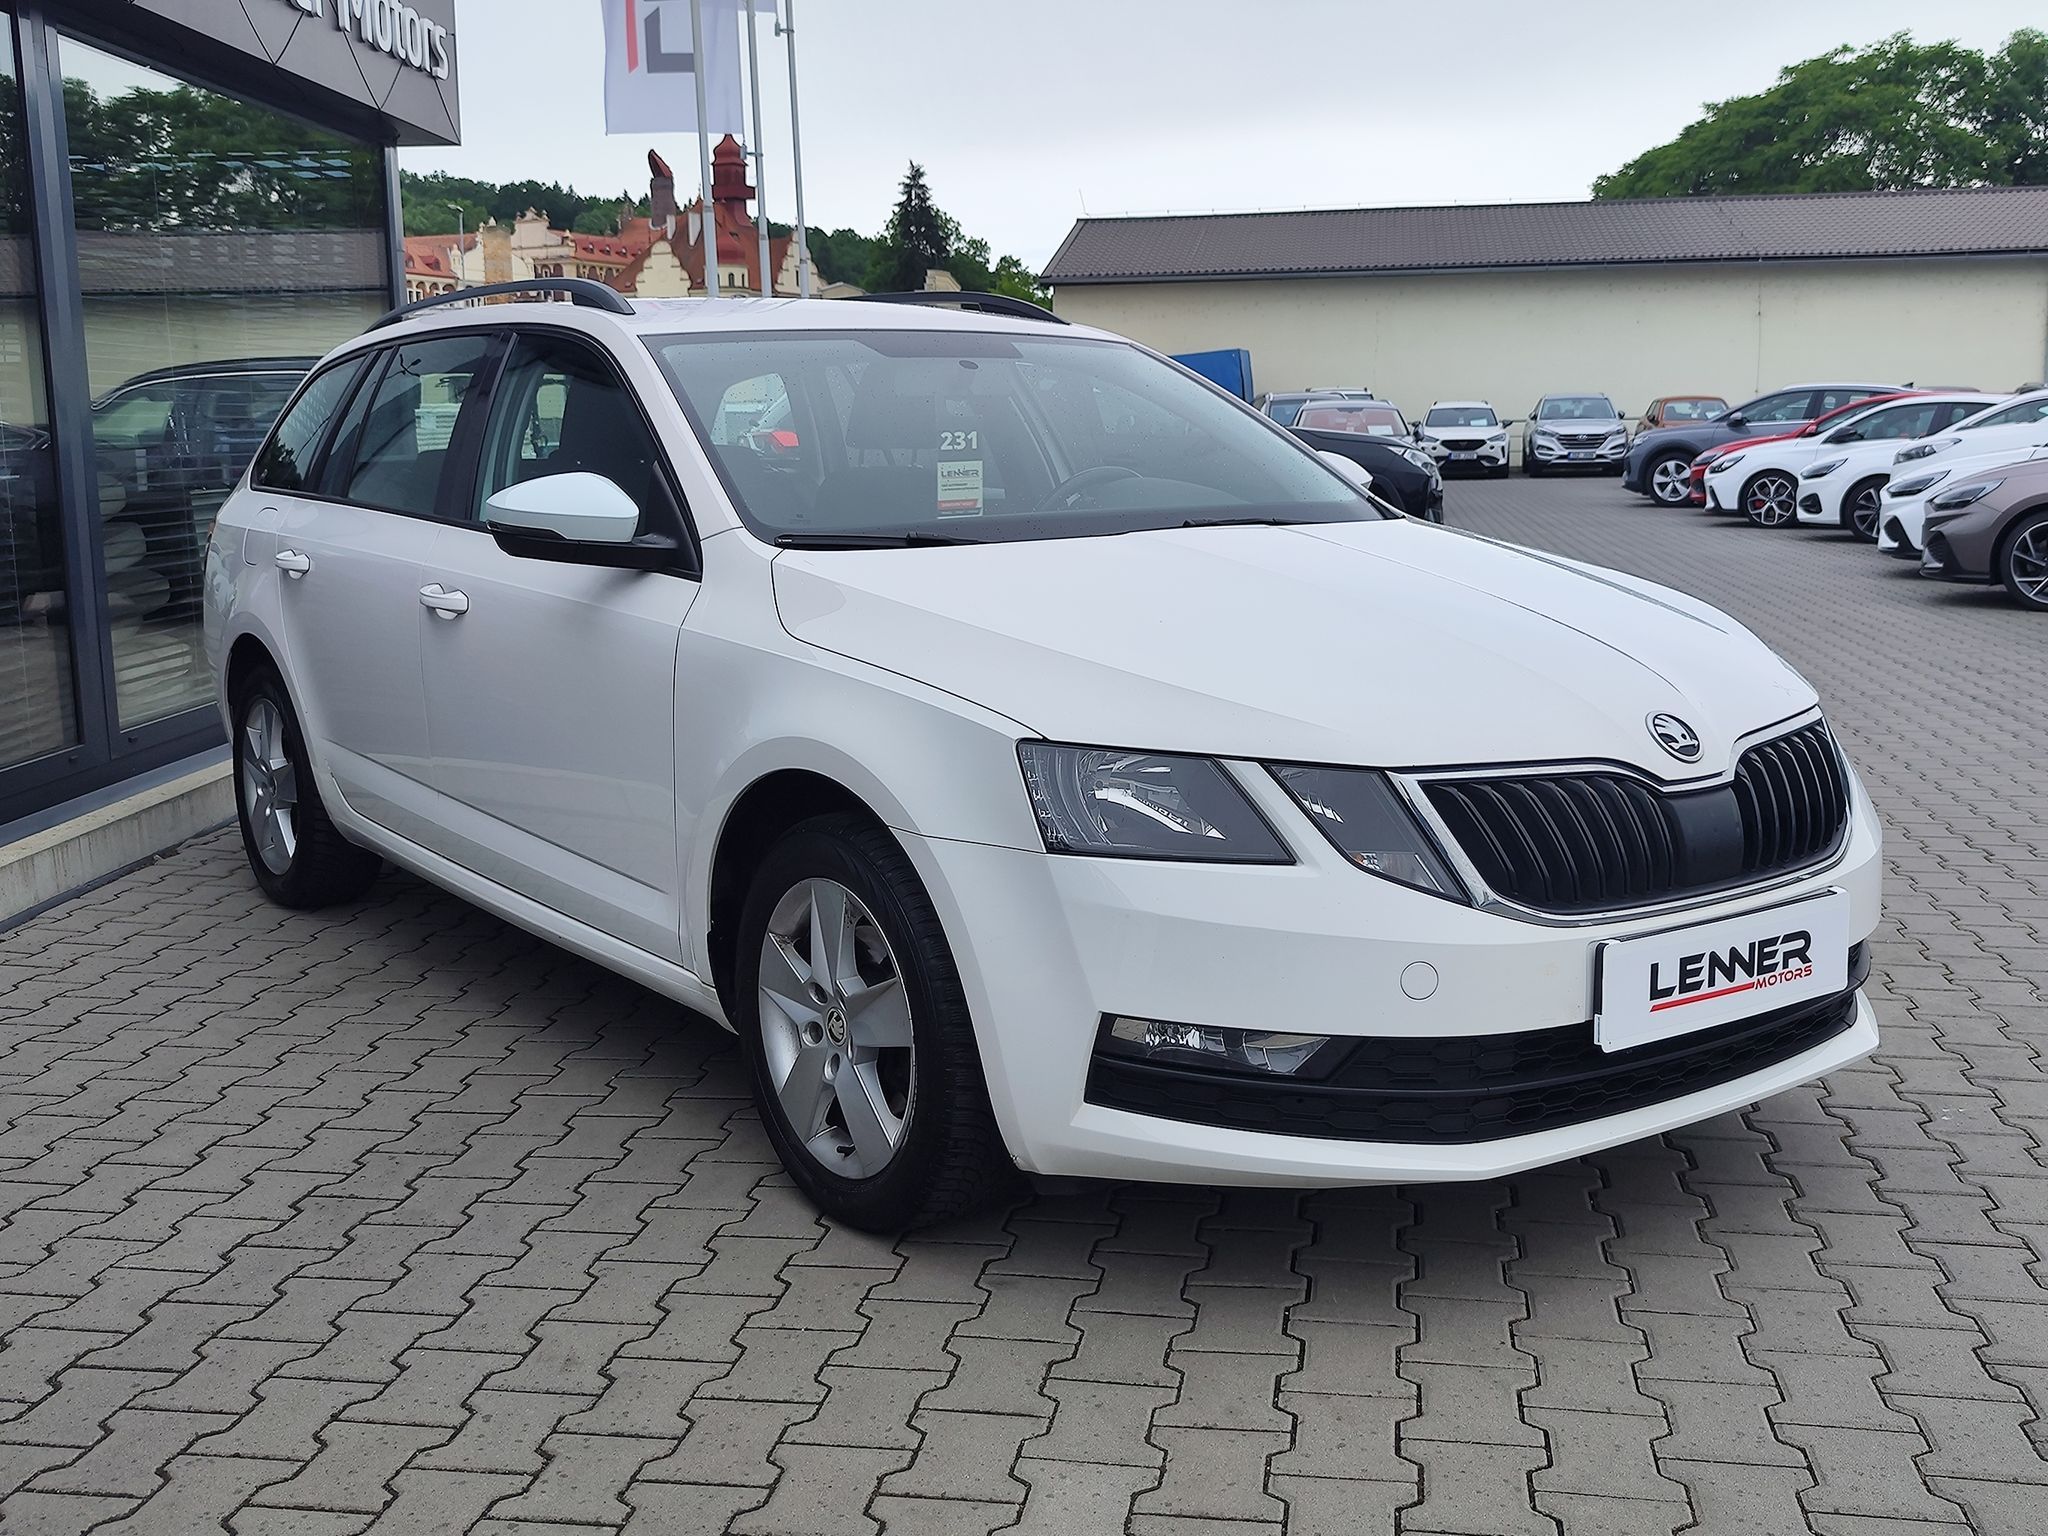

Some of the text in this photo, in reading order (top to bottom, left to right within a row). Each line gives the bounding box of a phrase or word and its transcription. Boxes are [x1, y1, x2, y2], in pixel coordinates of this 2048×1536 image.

[338, 0, 449, 80] Motors
[940, 431, 978, 451] 231
[1650, 930, 1812, 1001] LENNER
[1754, 964, 1812, 990] MOTORS
